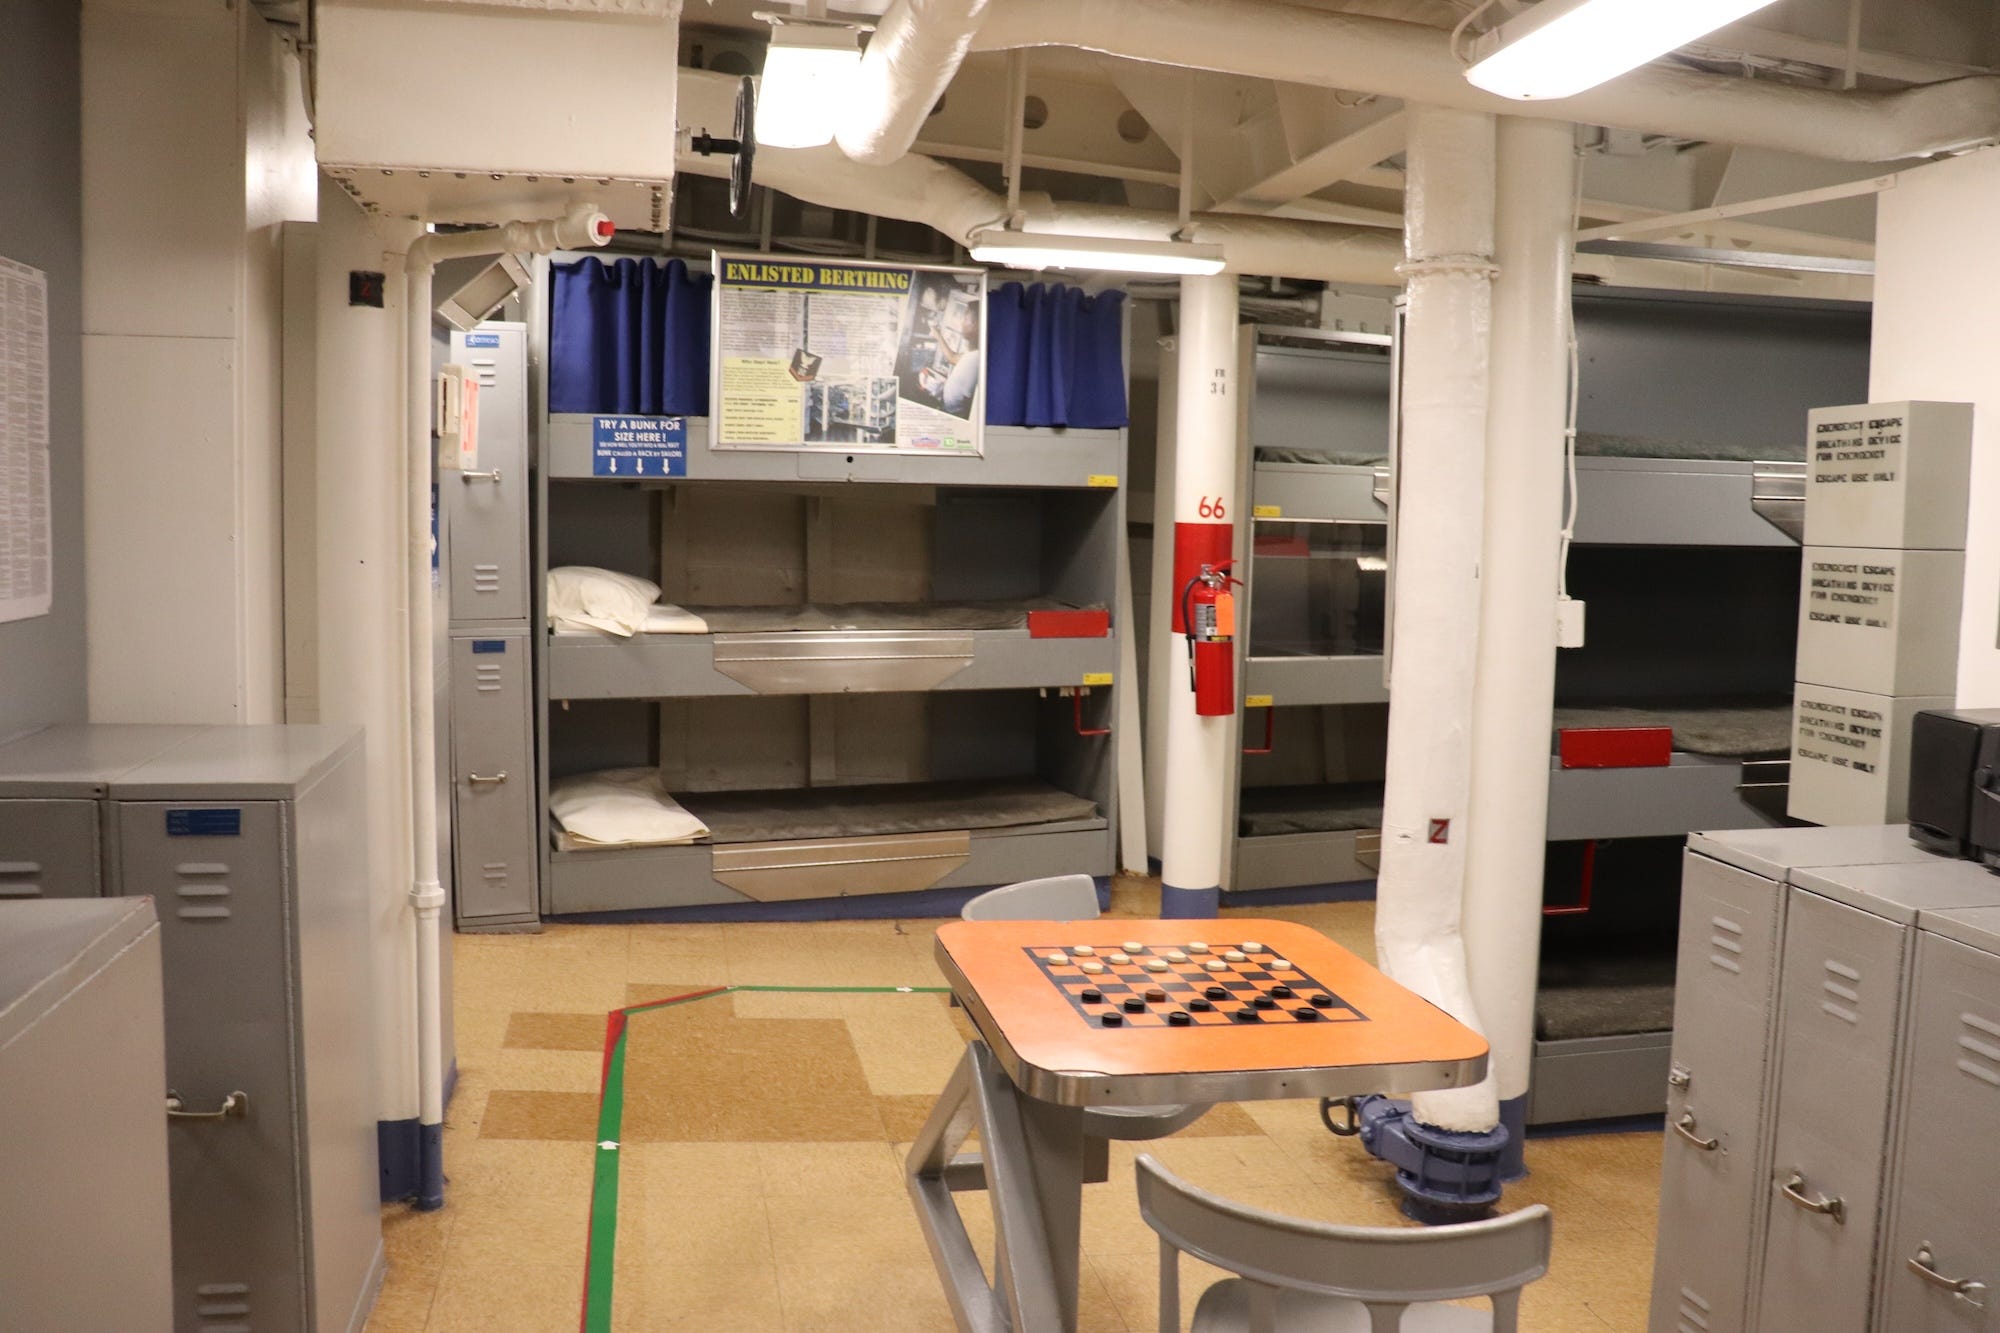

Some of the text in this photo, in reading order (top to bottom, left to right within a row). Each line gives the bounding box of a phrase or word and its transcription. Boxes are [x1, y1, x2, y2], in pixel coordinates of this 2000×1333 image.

[725, 263, 909, 290] ENLISTED BERTHING
[599, 420, 680, 431] TRY A BUNK FOR
[614, 432, 634, 442] SIZE
[636, 432, 660, 442] HERE
[1199, 496, 1225, 519] 66
[1863, 565, 1896, 575] ESCAPE
[1849, 724, 1882, 738] DEVICE
[1430, 819, 1449, 843] Z
